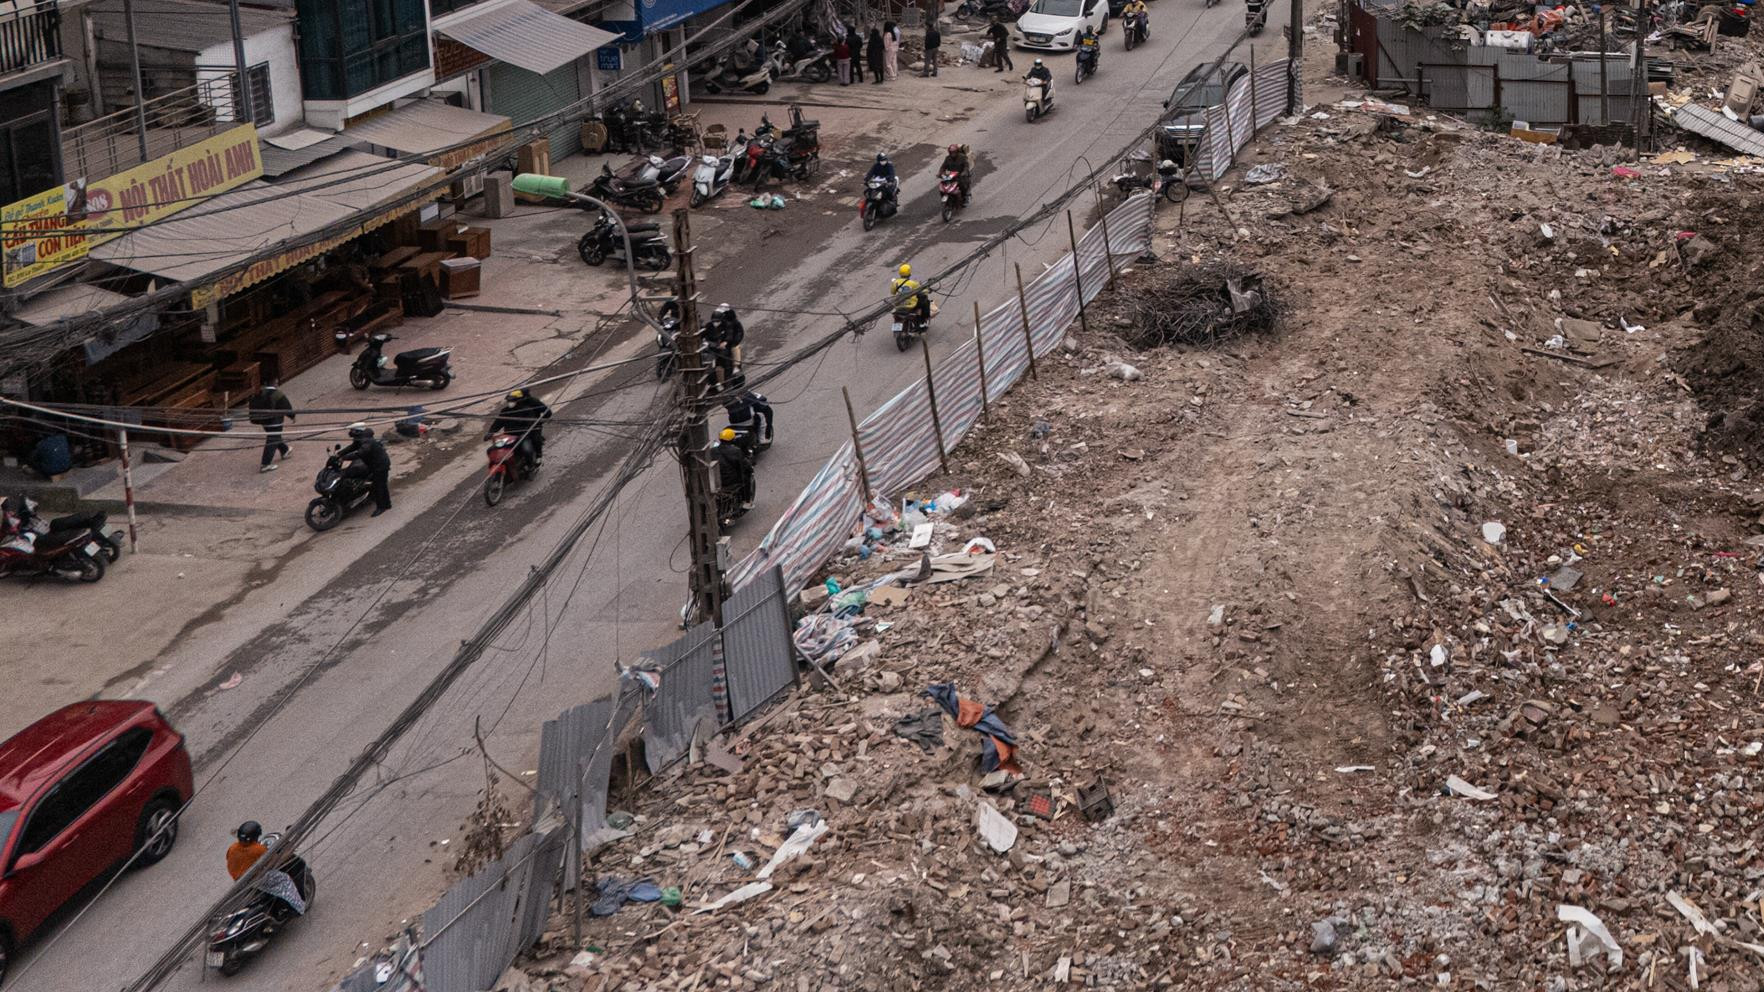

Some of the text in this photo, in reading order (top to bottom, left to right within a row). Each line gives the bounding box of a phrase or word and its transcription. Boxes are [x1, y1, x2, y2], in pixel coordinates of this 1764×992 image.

[119, 139, 257, 225] NỘI THẤT HOÀI ANH
